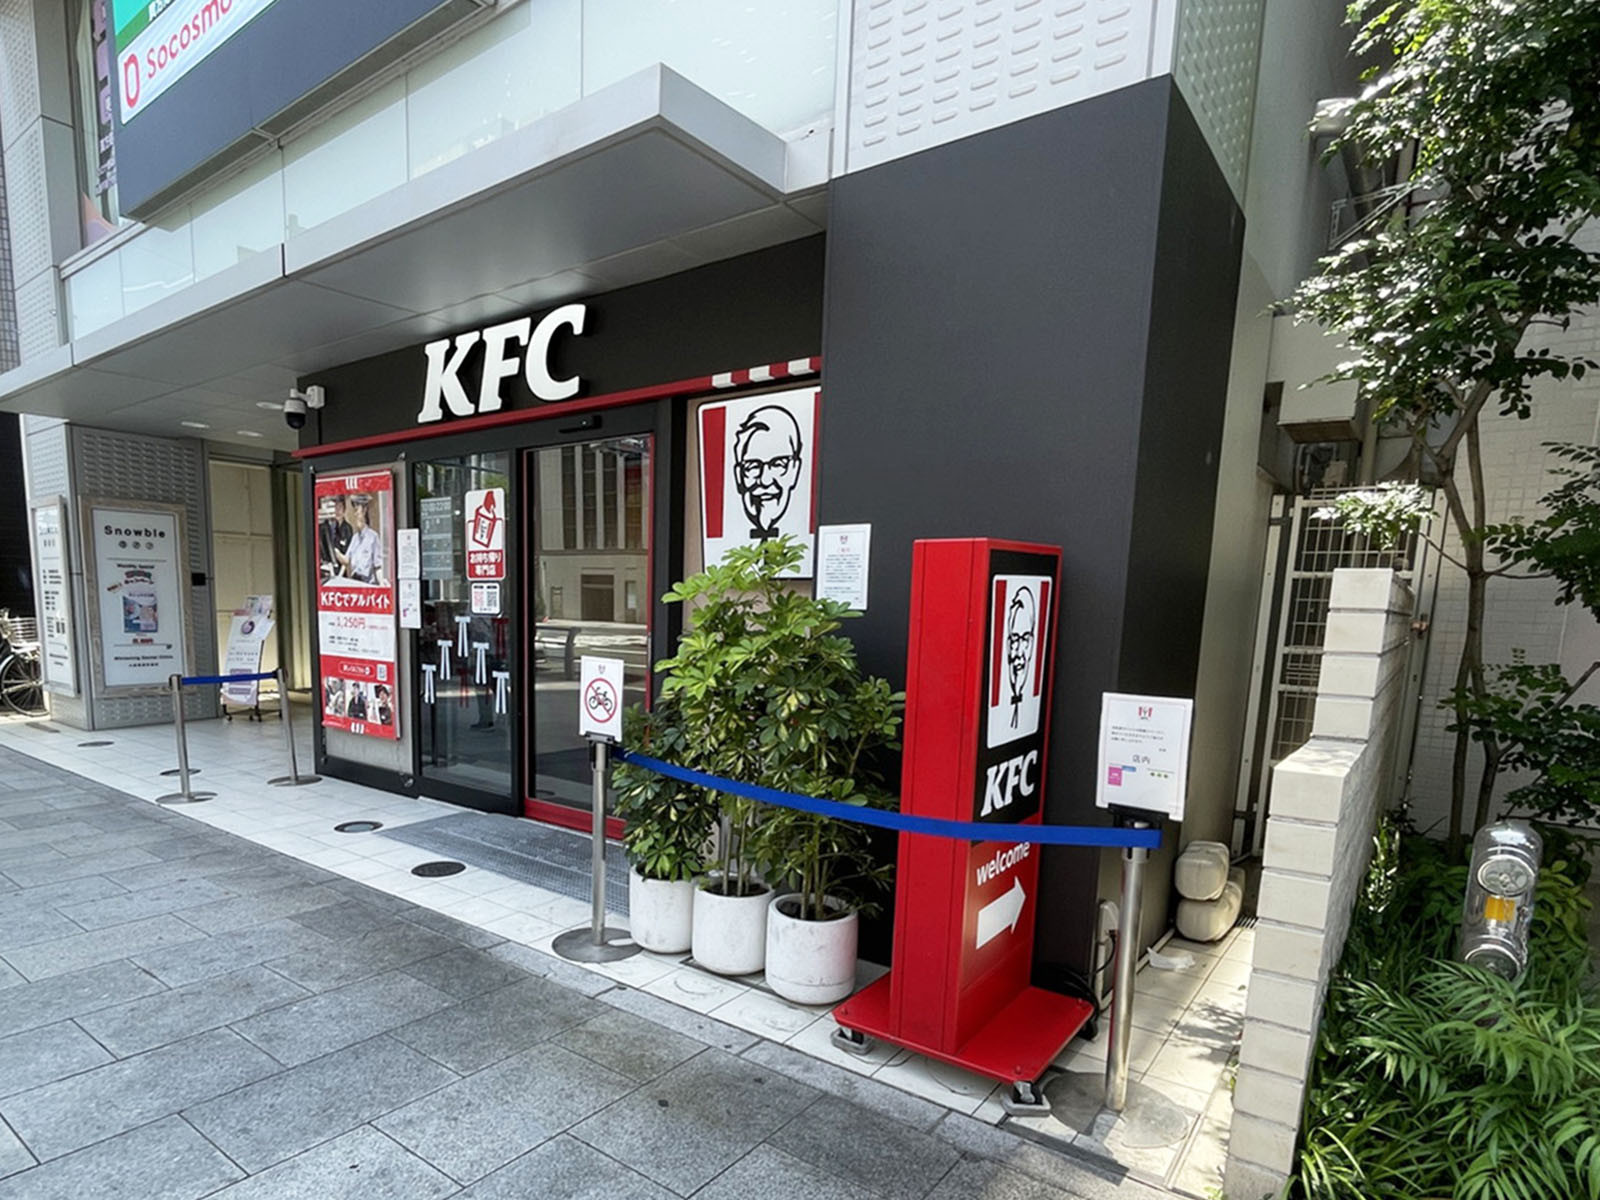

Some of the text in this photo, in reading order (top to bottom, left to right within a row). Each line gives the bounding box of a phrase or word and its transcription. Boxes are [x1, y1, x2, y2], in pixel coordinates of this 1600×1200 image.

[417, 304, 586, 423] KFC
[104, 525, 165, 538] Snowble
[320, 591, 391, 609] KFCでアルバイト
[980, 750, 1038, 817] KFC
[976, 841, 1031, 886] welcome
